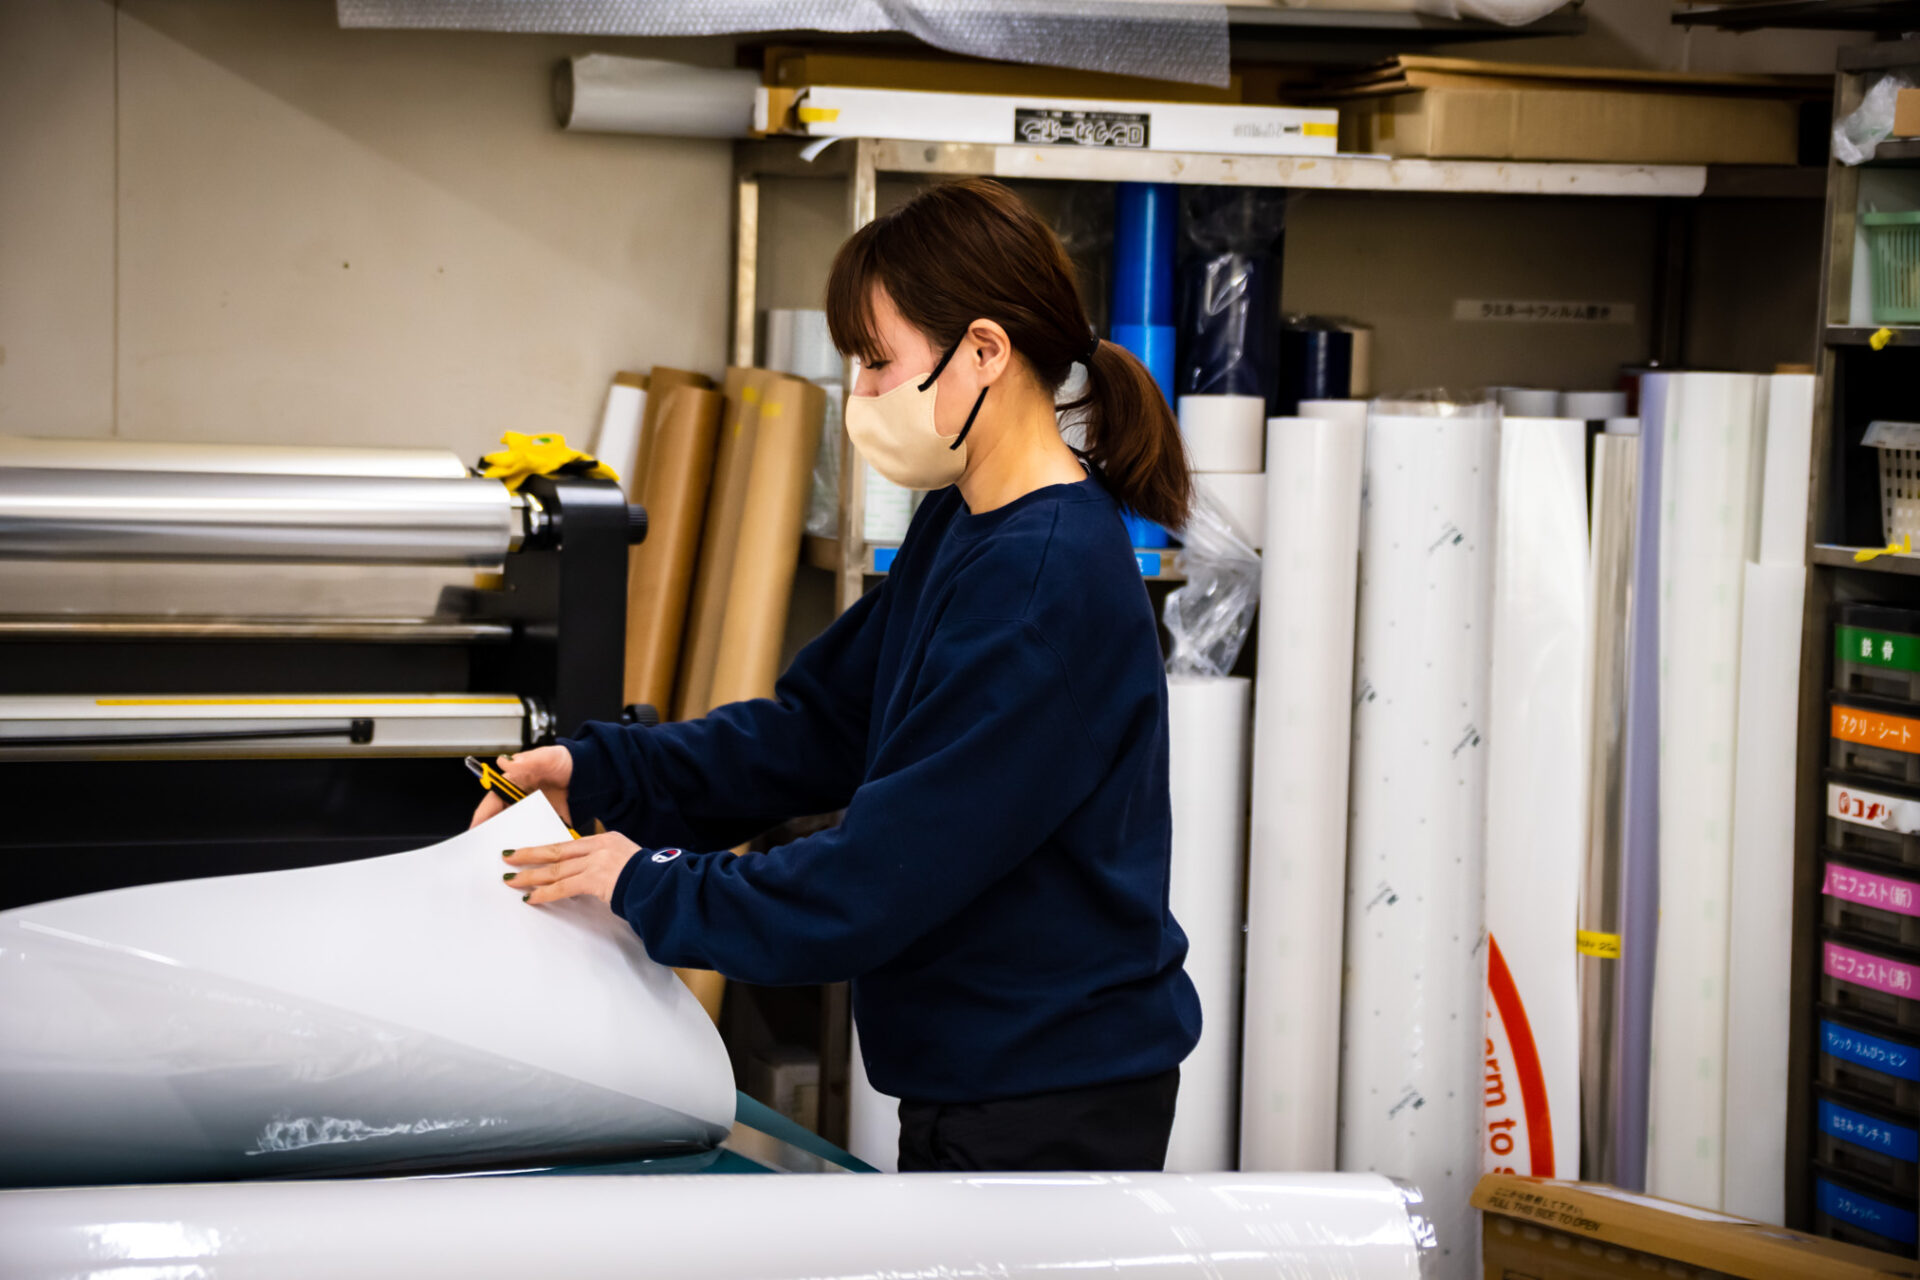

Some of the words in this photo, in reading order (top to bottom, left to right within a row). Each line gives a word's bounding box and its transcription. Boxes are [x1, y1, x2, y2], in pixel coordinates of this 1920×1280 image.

[1489, 1118, 1517, 1156] to
[1487, 1196, 1509, 1210] PULL
[1513, 1202, 1533, 1215] THIS
[1535, 1207, 1557, 1220] SIDE
[1558, 1213, 1573, 1225] TO
[1573, 1217, 1601, 1232] OPEN
